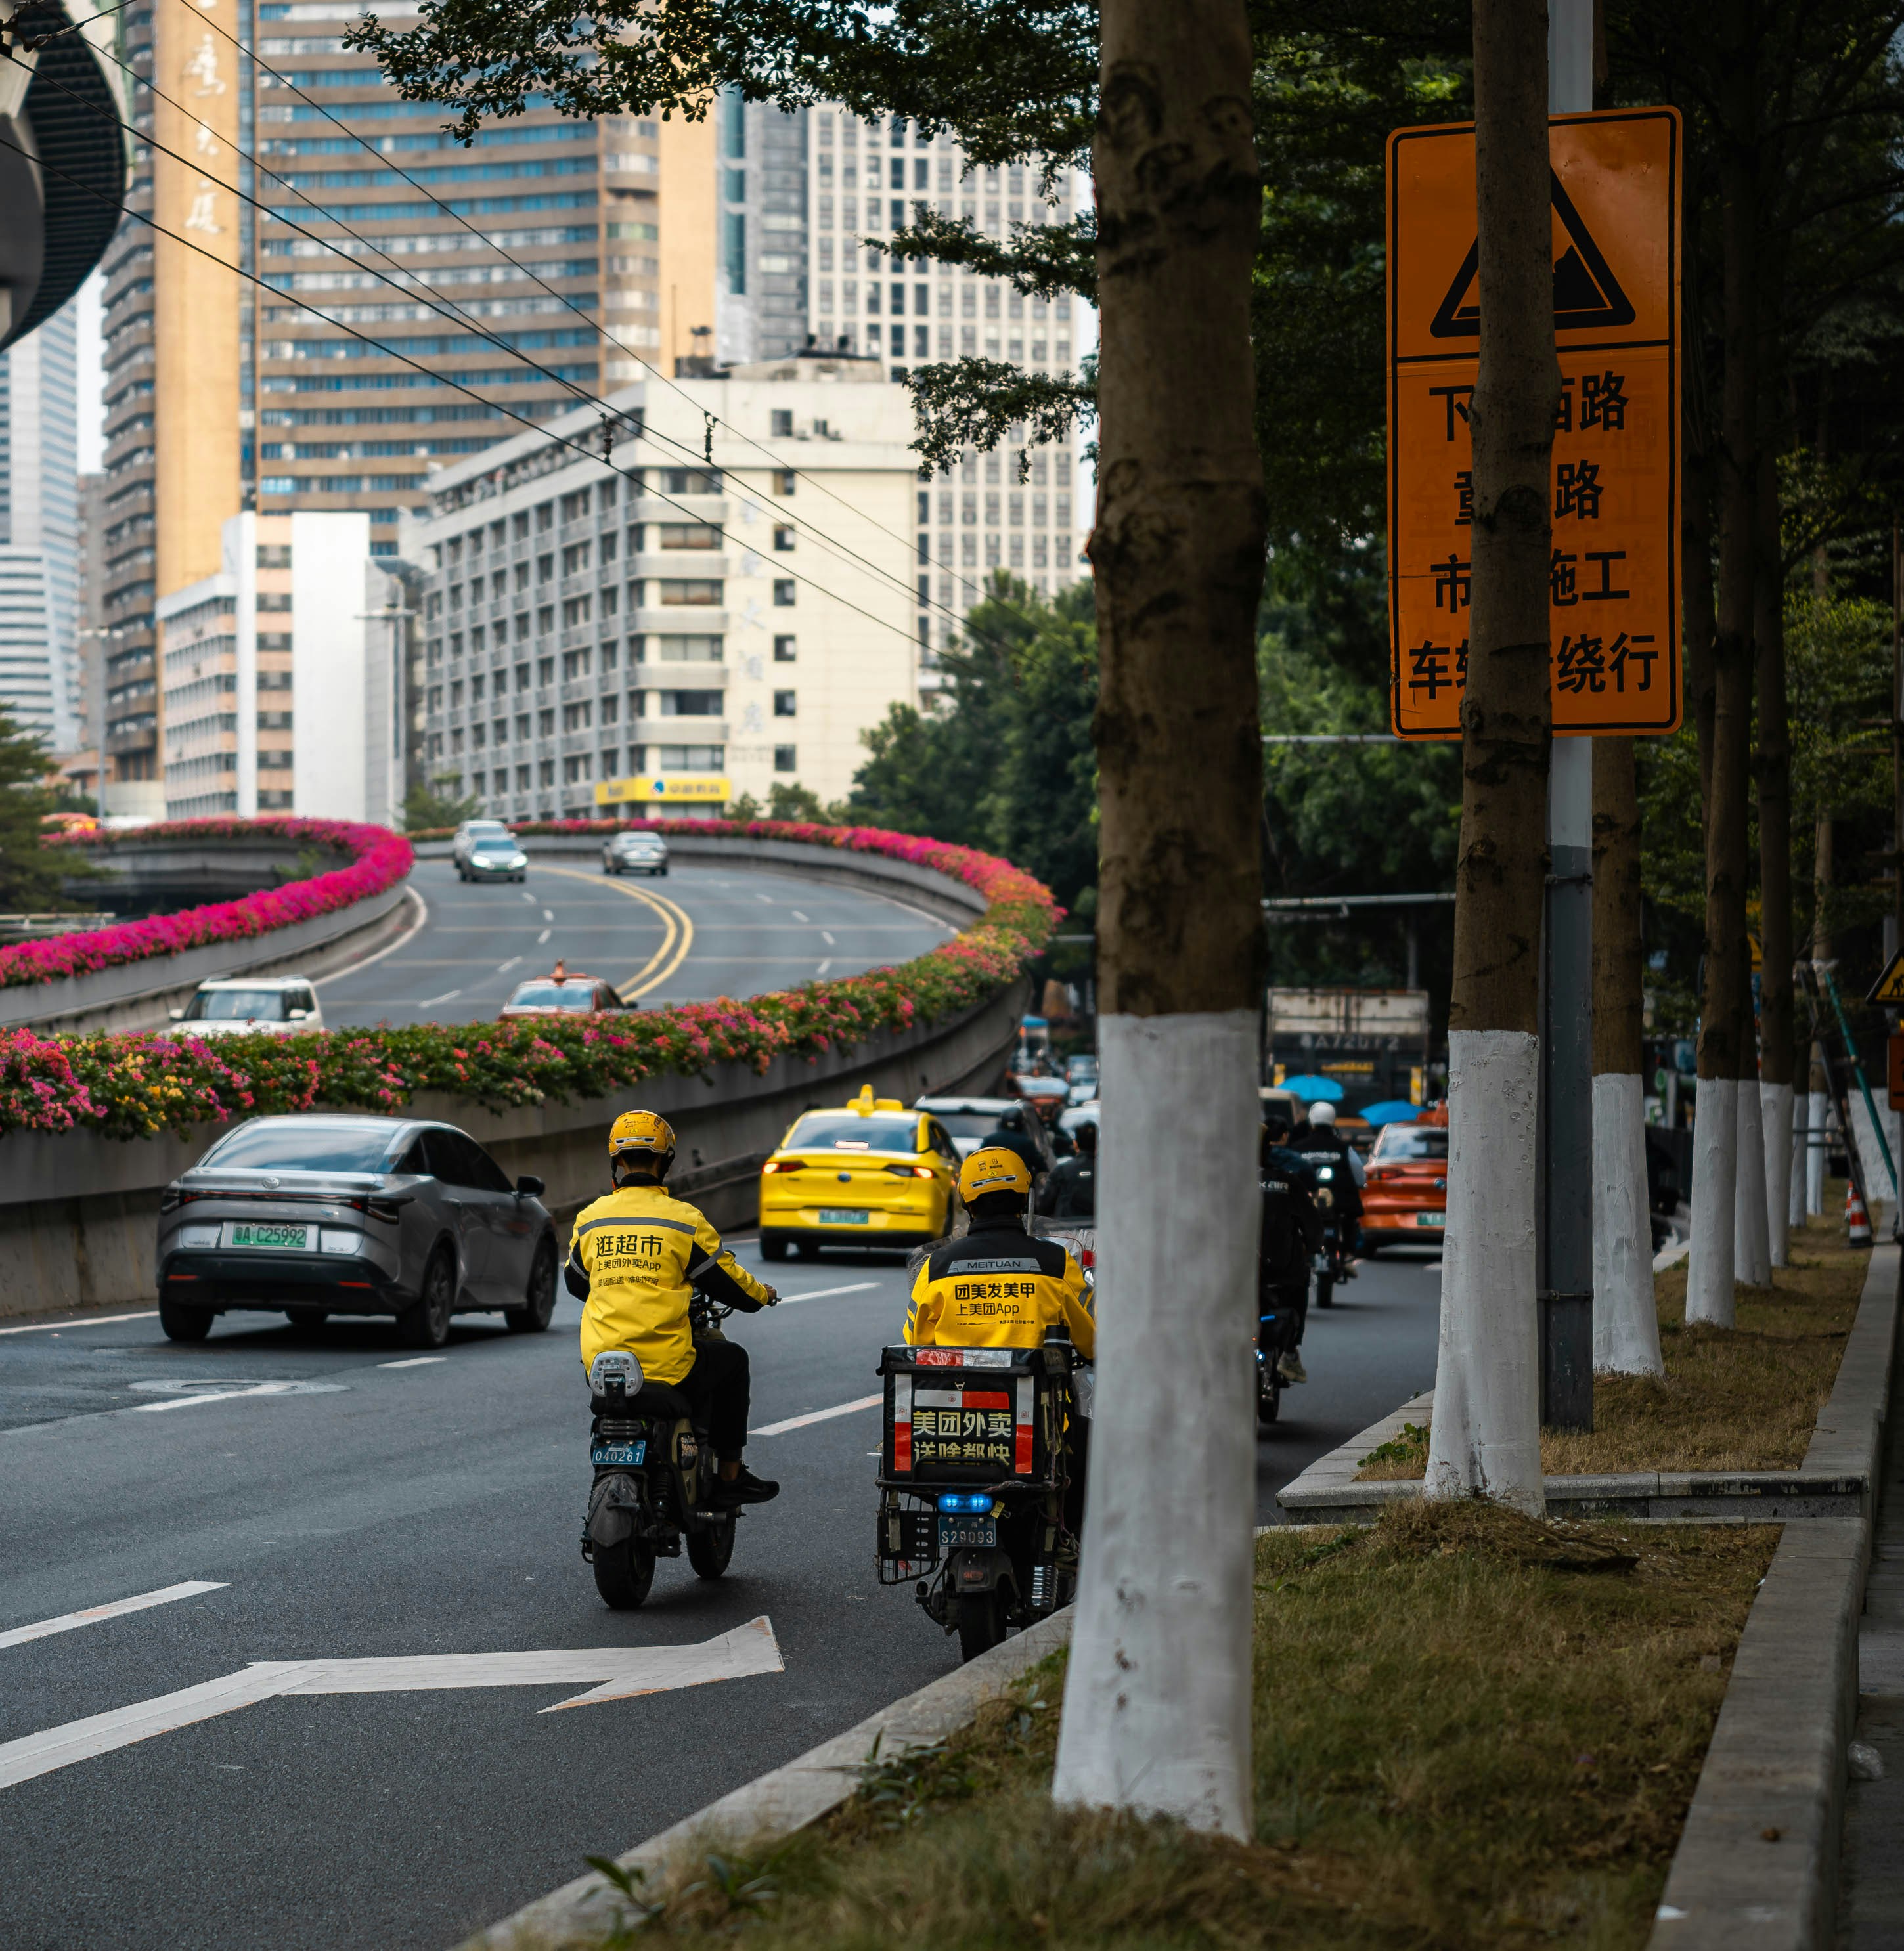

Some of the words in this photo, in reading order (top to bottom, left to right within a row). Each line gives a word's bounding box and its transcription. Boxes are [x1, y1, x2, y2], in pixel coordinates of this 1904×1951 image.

[1429, 370, 1629, 442] 下路
[1430, 548, 1630, 613] 市施工
[1408, 632, 1659, 700] 车绕行
[596, 1235, 664, 1258] 逛超市
[597, 1258, 661, 1272] 上美团外卖App
[955, 1282, 1035, 1300] 团美发美甲
[956, 1303, 1019, 1317] 上美团App
[912, 1411, 1011, 1437] 美团外卖
[914, 1441, 1010, 1466] 送啥都快
[941, 1531, 994, 1543] S29093
